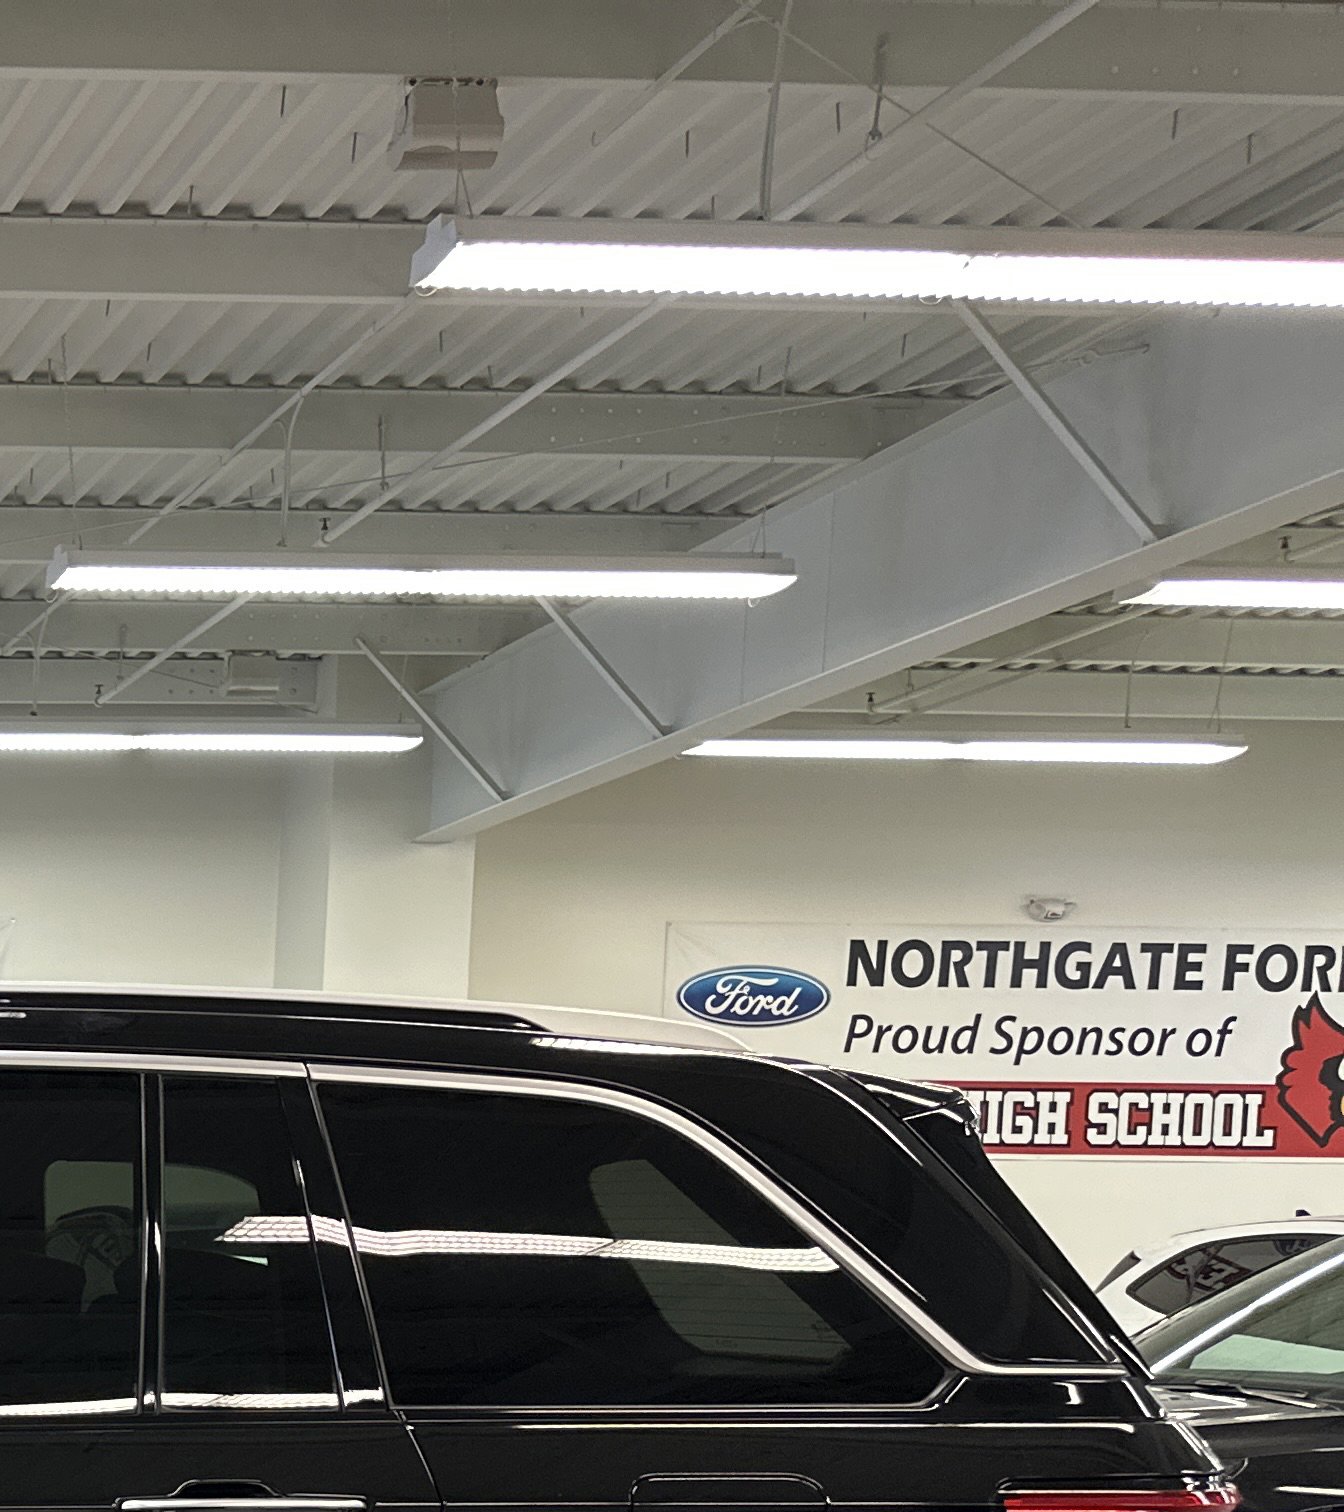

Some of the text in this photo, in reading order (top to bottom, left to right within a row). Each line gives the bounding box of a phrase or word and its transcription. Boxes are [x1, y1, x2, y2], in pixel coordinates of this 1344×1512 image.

[846, 939, 1344, 993] NORTHGATE FOR
[844, 1013, 1238, 1066] Proud Sponsor of
[1085, 1091, 1275, 1148] SCHOOL
